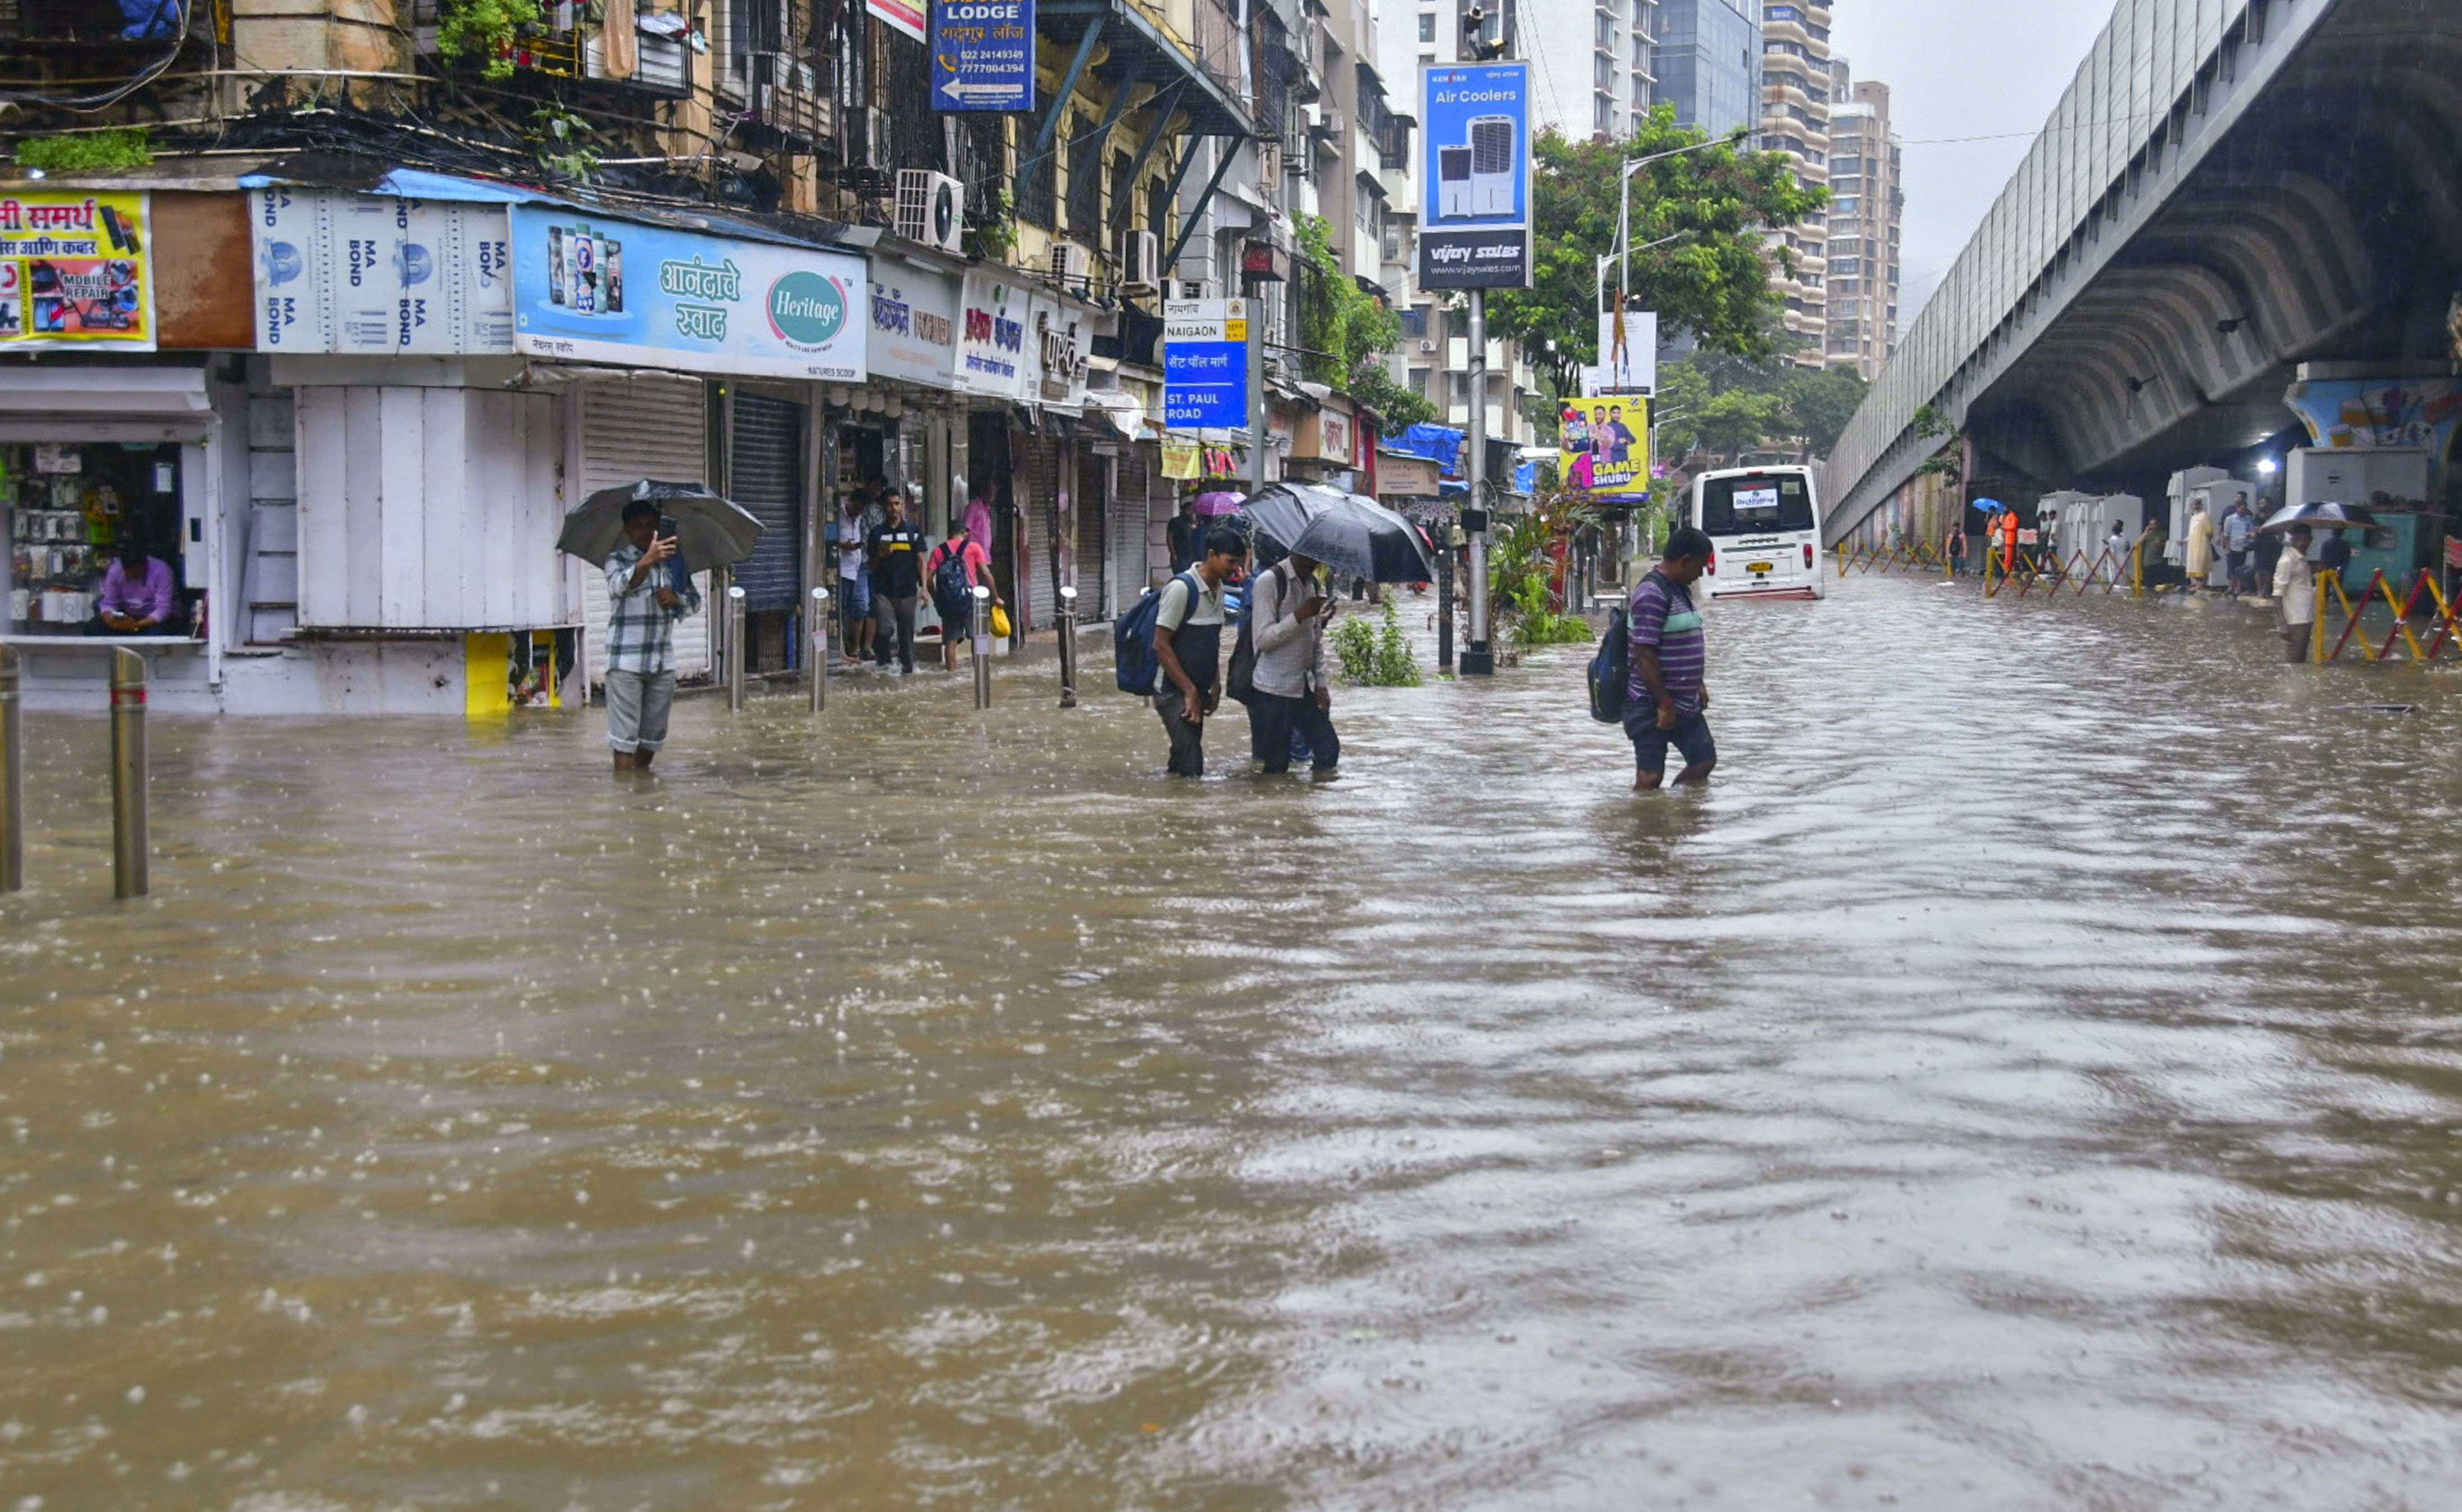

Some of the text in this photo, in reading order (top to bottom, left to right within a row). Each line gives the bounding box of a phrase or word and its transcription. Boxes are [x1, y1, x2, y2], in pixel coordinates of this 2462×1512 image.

[948, 6, 1019, 19] LODGE
[1436, 89, 1517, 103] Air Coolers
[28, 199, 94, 230] समर्थ
[349, 240, 361, 287] BOND
[365, 240, 376, 268] MA
[495, 242, 506, 270] MA
[1431, 244, 1521, 263] vijay sales
[63, 275, 111, 285] MOBILE
[662, 256, 740, 300] आनंदाचे
[66, 288, 108, 299] REPAIR
[284, 298, 295, 326] MA
[415, 299, 426, 327] MA
[776, 290, 839, 327] Heritage
[269, 298, 280, 344] BOND
[399, 299, 411, 345] BOND
[676, 303, 727, 342] स्वाद
[1167, 326, 1217, 337] NAIGAON
[1188, 354, 1208, 368] पॉल
[1209, 353, 1228, 368] मार्ग
[1168, 394, 1219, 404] ST. PAUL
[1168, 408, 1202, 420] ROAD
[1593, 458, 1640, 476] GAME
[1593, 473, 1631, 486] SHURU
